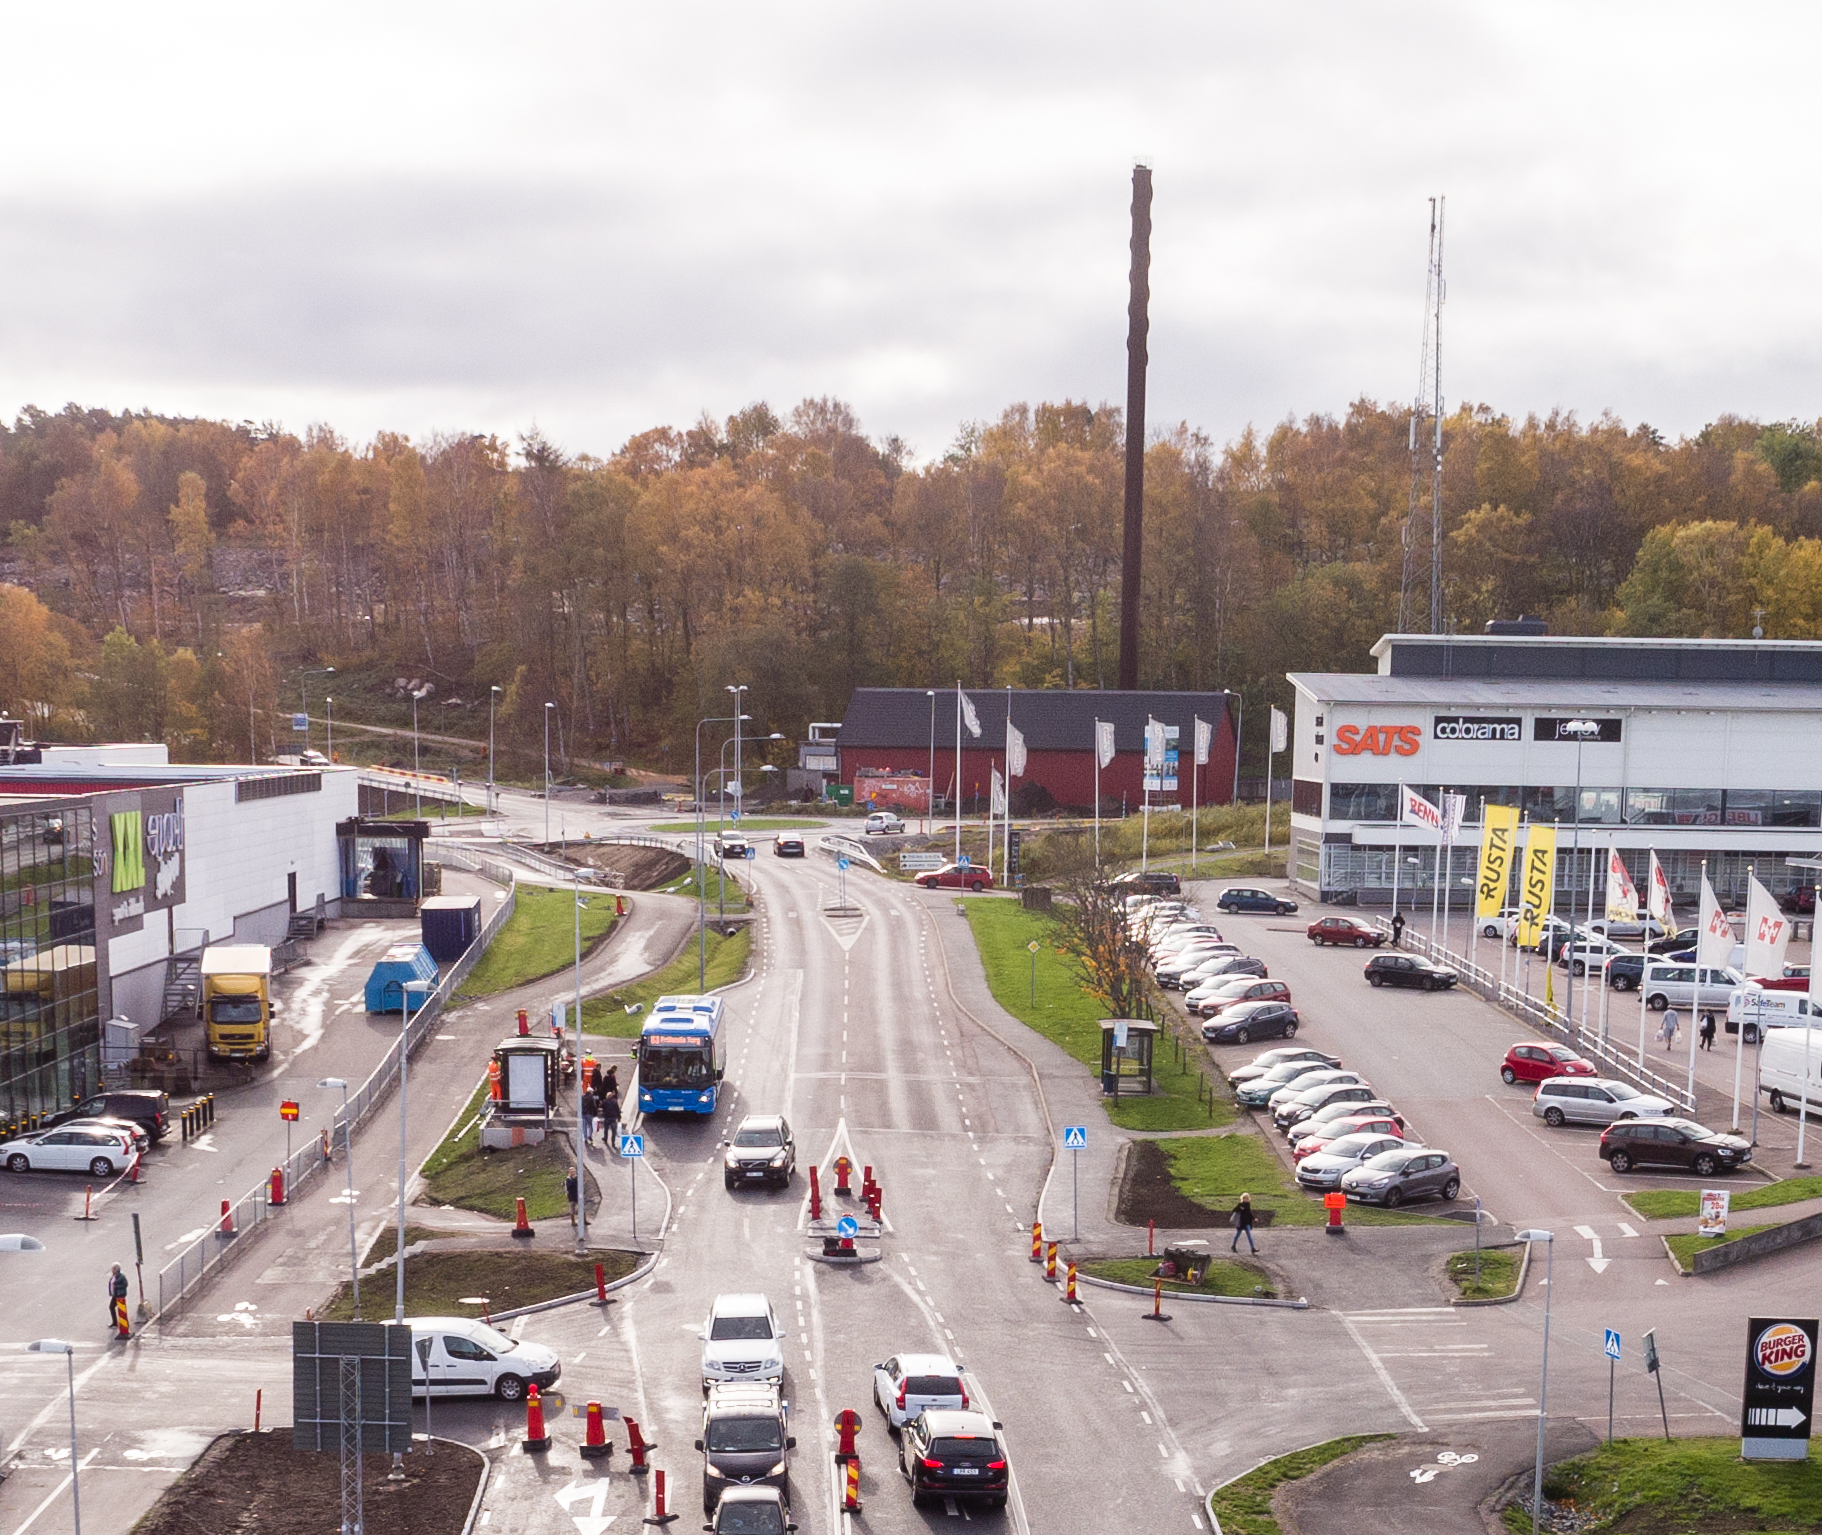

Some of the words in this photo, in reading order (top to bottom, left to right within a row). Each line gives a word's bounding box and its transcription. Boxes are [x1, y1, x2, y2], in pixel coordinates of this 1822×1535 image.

[1333, 725, 1422, 756] SATS
[1436, 718, 1519, 740] colorama
[1480, 826, 1510, 901] RUSTA
[1523, 848, 1549, 929] RUSTA
[1760, 1334, 1805, 1353] BURGER
[1760, 1344, 1807, 1368] KING
